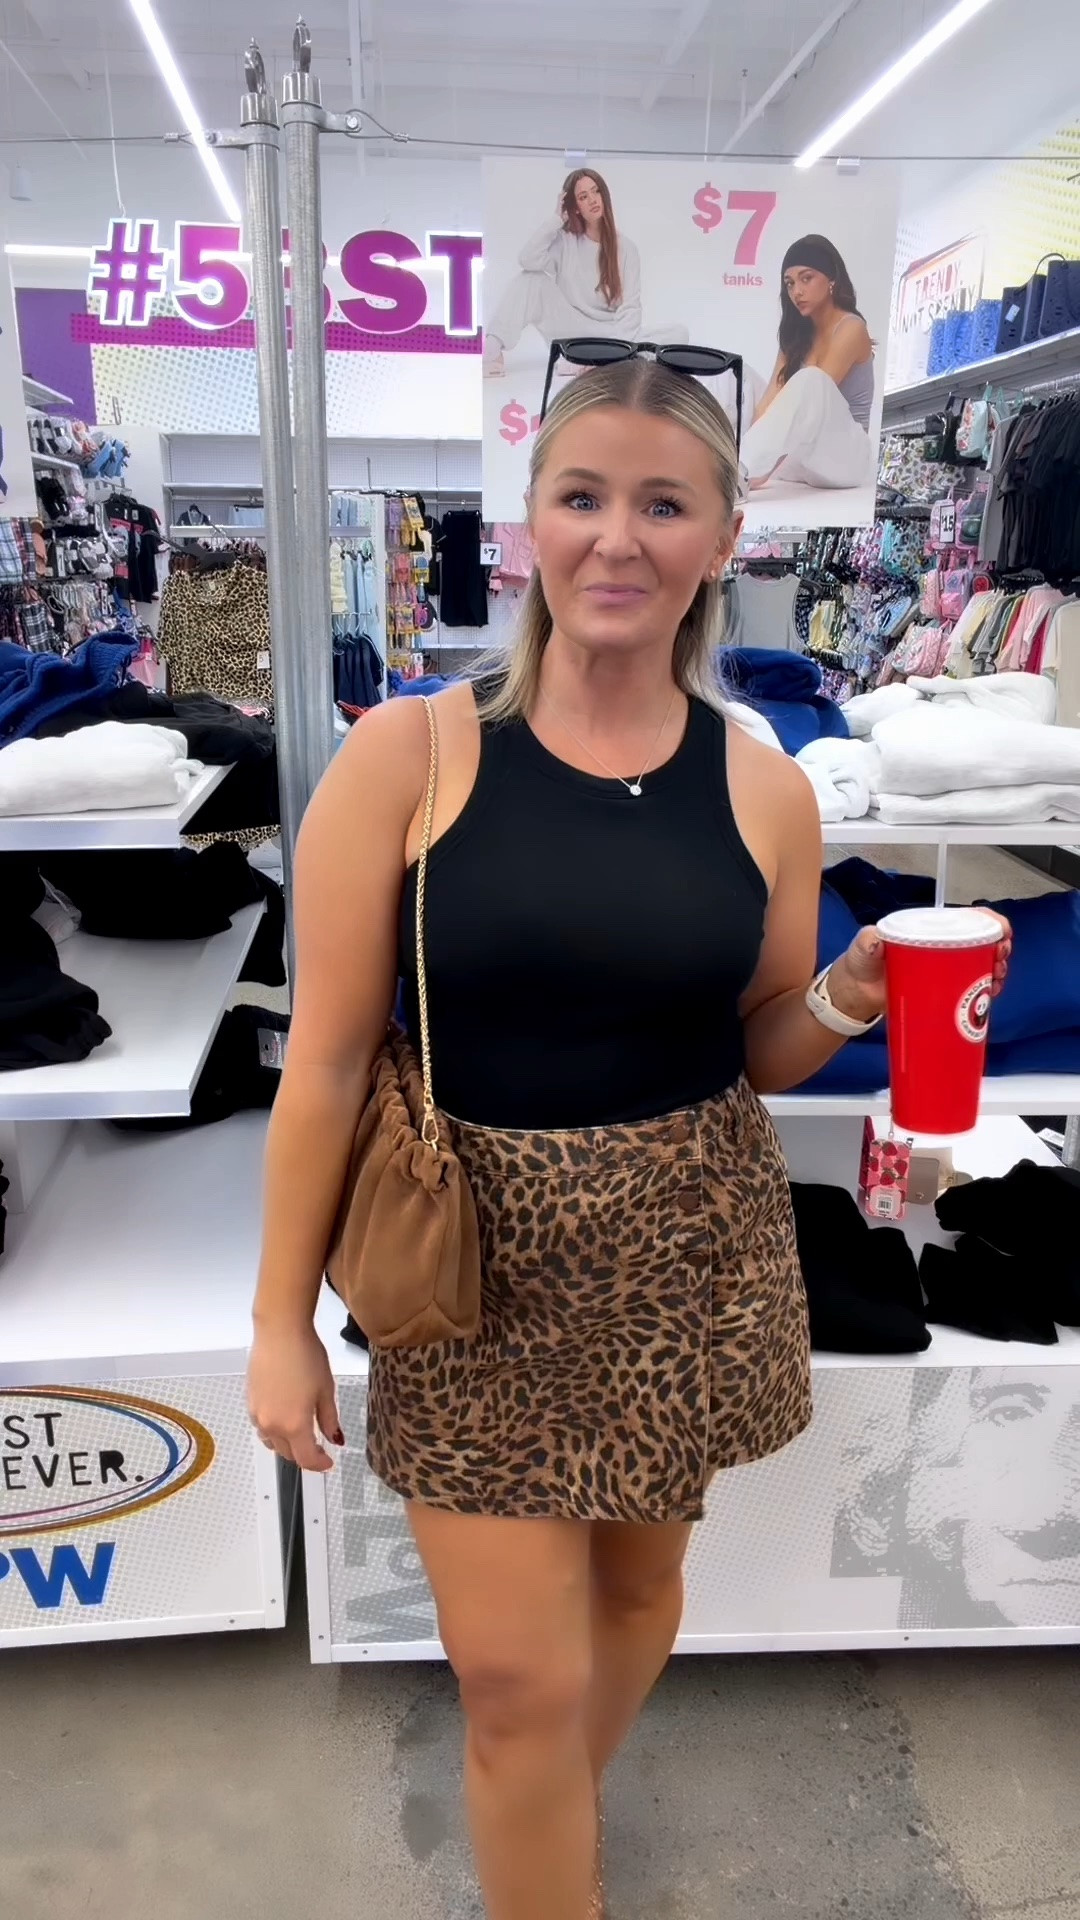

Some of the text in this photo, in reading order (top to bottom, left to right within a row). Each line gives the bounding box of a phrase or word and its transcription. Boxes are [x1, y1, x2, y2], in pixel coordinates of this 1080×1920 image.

[692, 181, 777, 265] $7
[722, 273, 763, 286] tanks
[484, 547, 497, 561] $7
[961, 981, 983, 1009] PANDA
[3, 1412, 62, 1449] ST
[2, 1450, 144, 1490] EVER.
